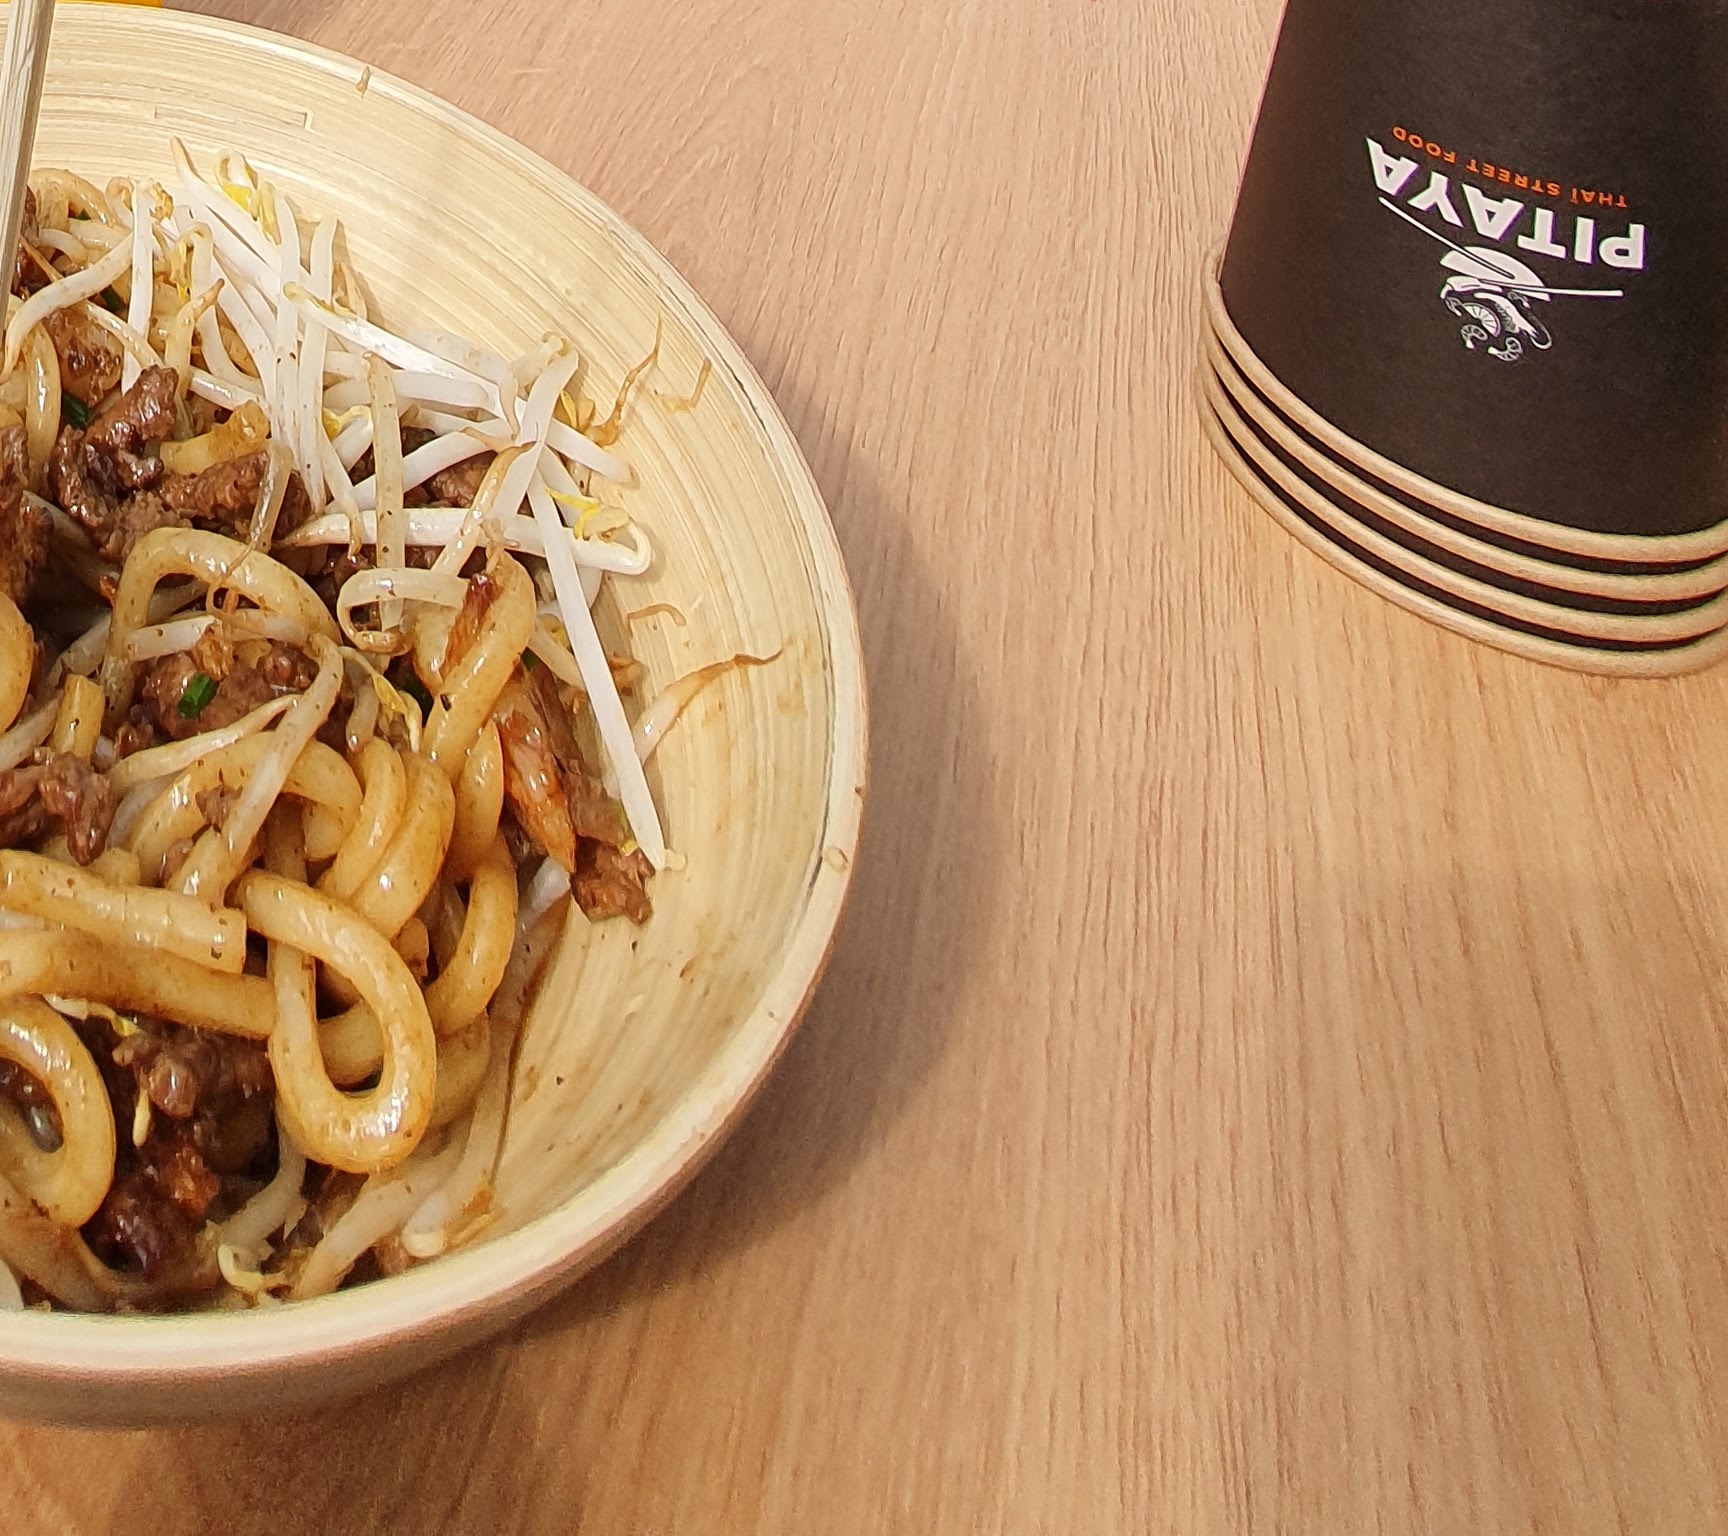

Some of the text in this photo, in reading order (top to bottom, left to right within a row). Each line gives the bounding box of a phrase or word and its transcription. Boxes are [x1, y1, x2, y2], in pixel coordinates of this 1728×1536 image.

[1392, 125, 1457, 164] FOOD
[1465, 158, 1562, 198] STREET
[1365, 136, 1646, 271] PITAYA
